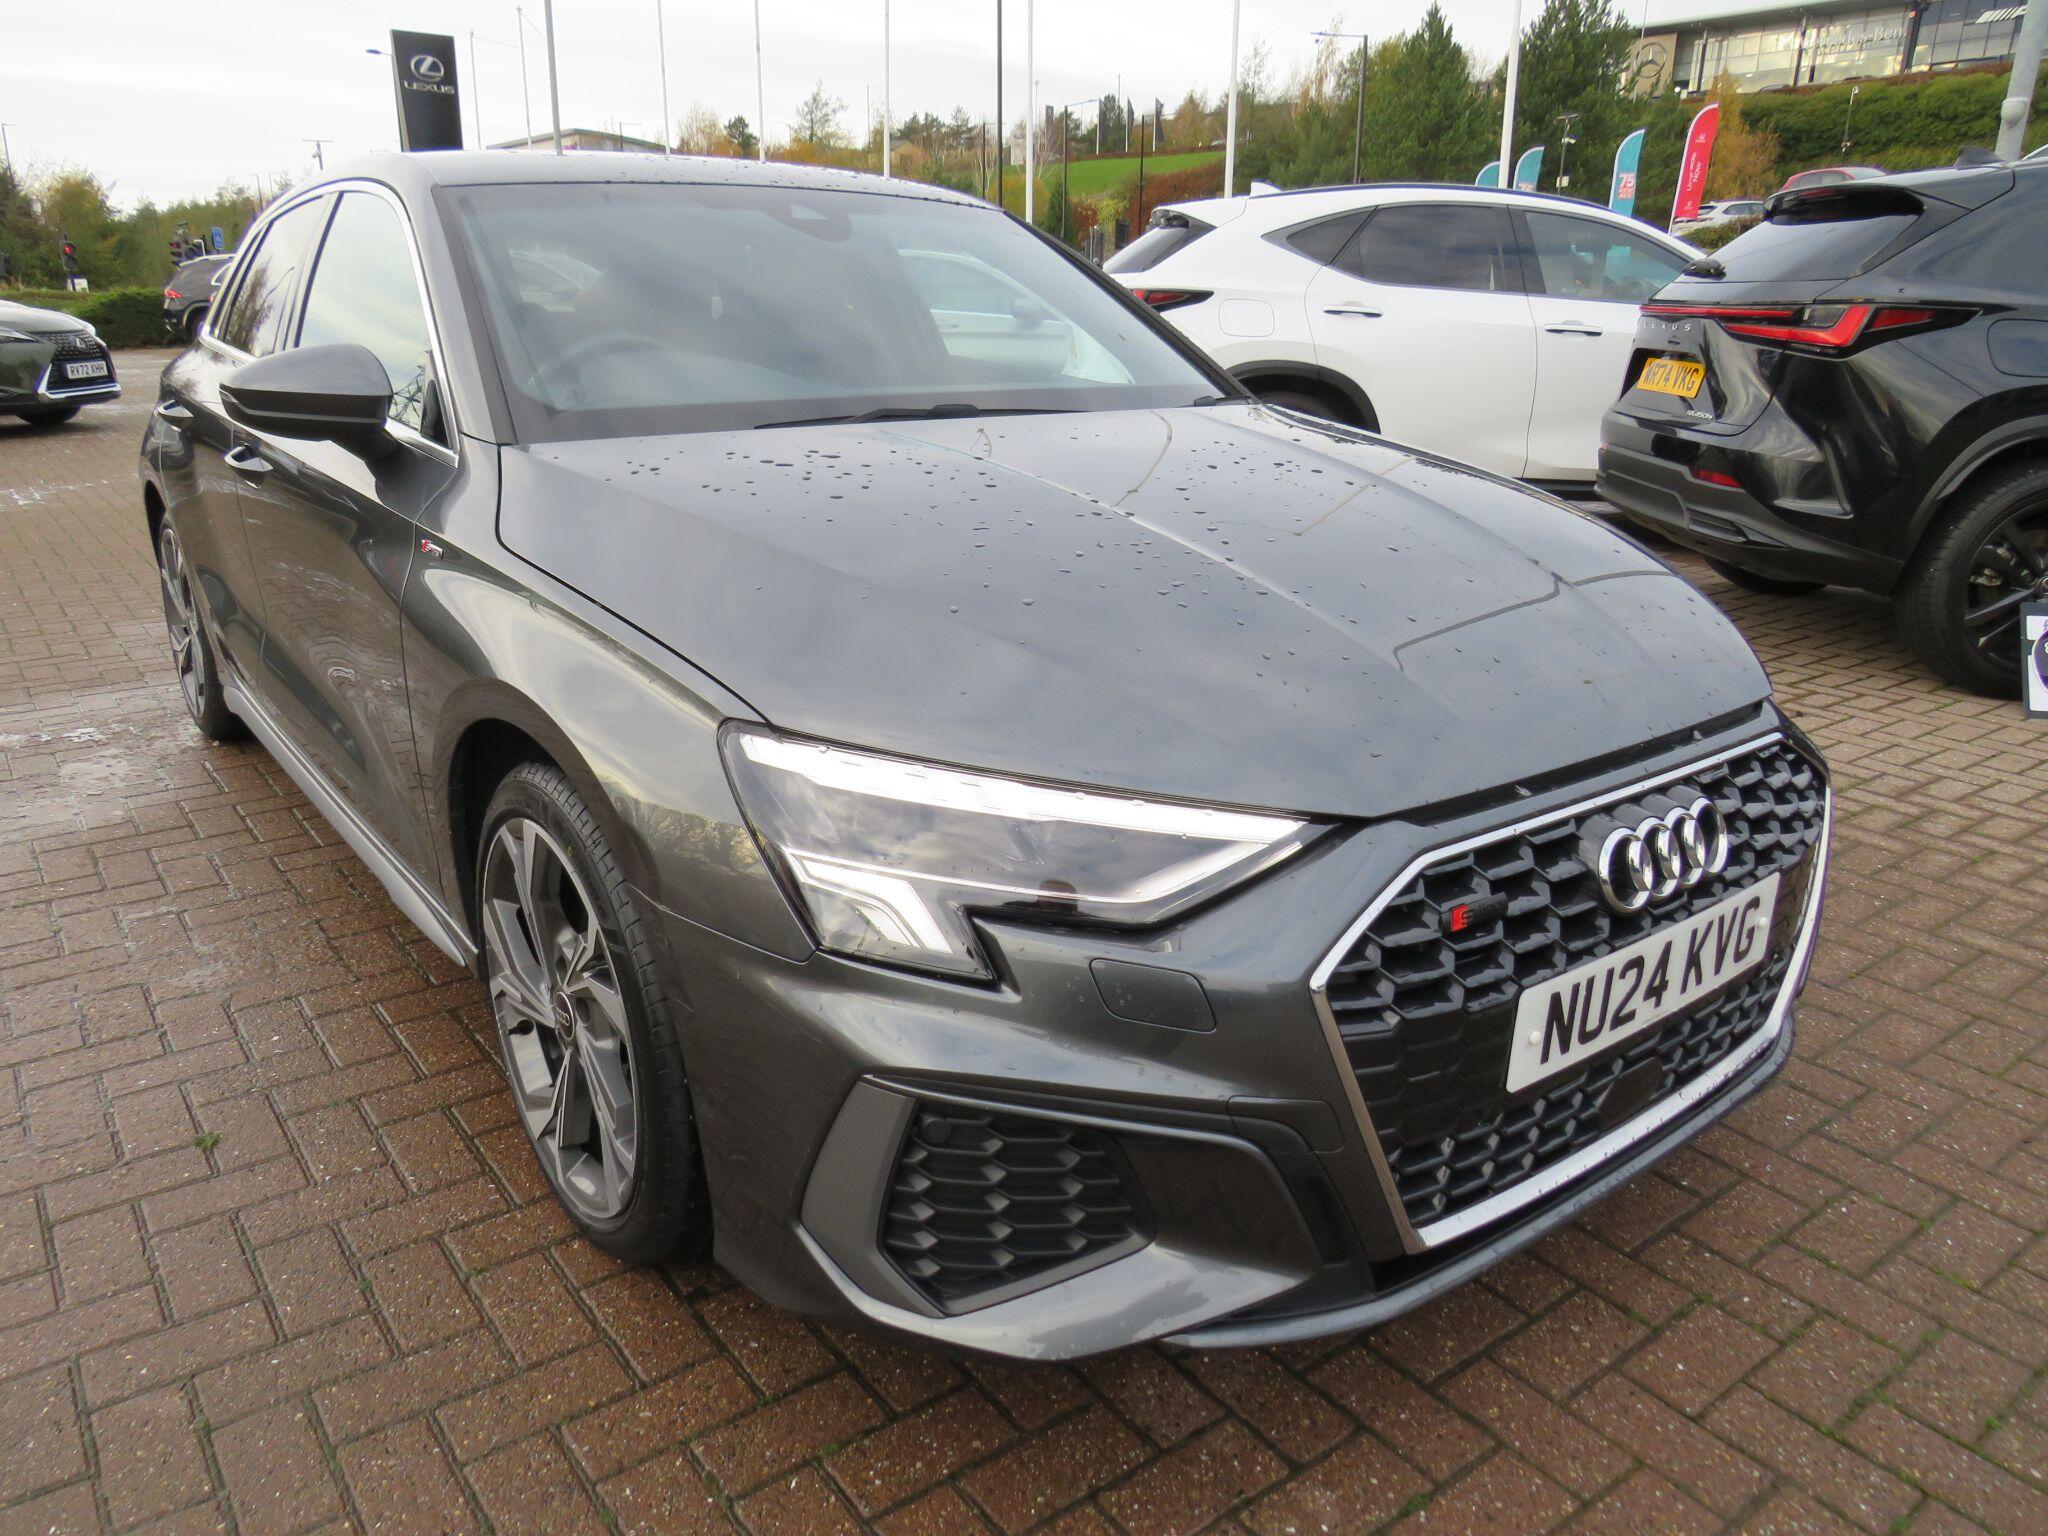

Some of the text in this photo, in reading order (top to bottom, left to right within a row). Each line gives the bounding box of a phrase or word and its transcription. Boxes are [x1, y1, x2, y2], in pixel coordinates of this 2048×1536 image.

[403, 80, 455, 95] LEXUS
[1643, 322, 1693, 332] LEXUS
[1673, 365, 1700, 392] VKG
[1540, 895, 1761, 1065] NU24 KVG
